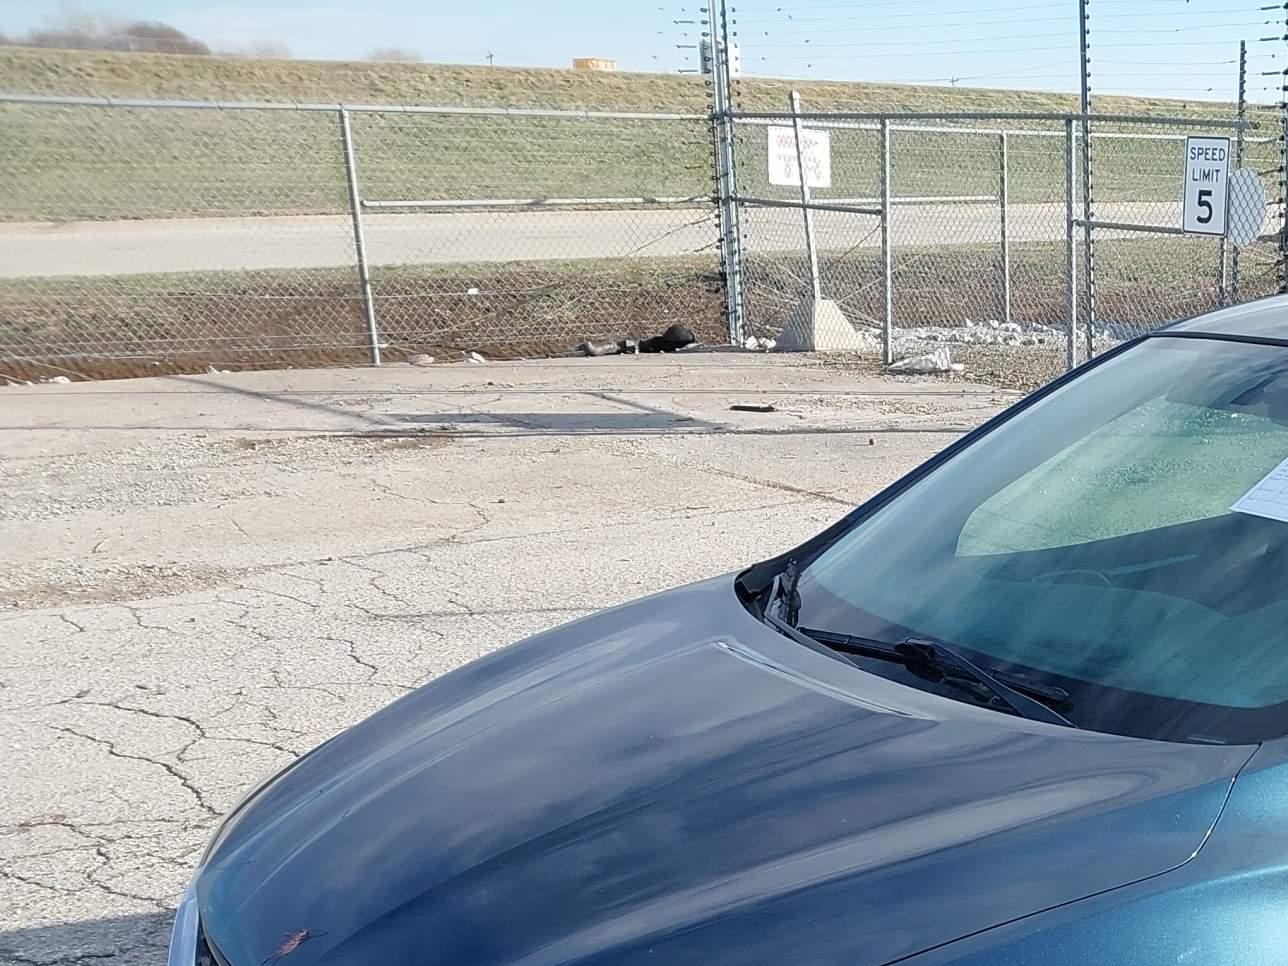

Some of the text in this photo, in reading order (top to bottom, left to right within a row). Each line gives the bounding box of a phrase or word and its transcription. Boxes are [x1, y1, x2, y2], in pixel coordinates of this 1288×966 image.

[1190, 147, 1226, 161] SPEED
[1192, 168, 1220, 183] LIMIT
[1196, 189, 1213, 224] 5
